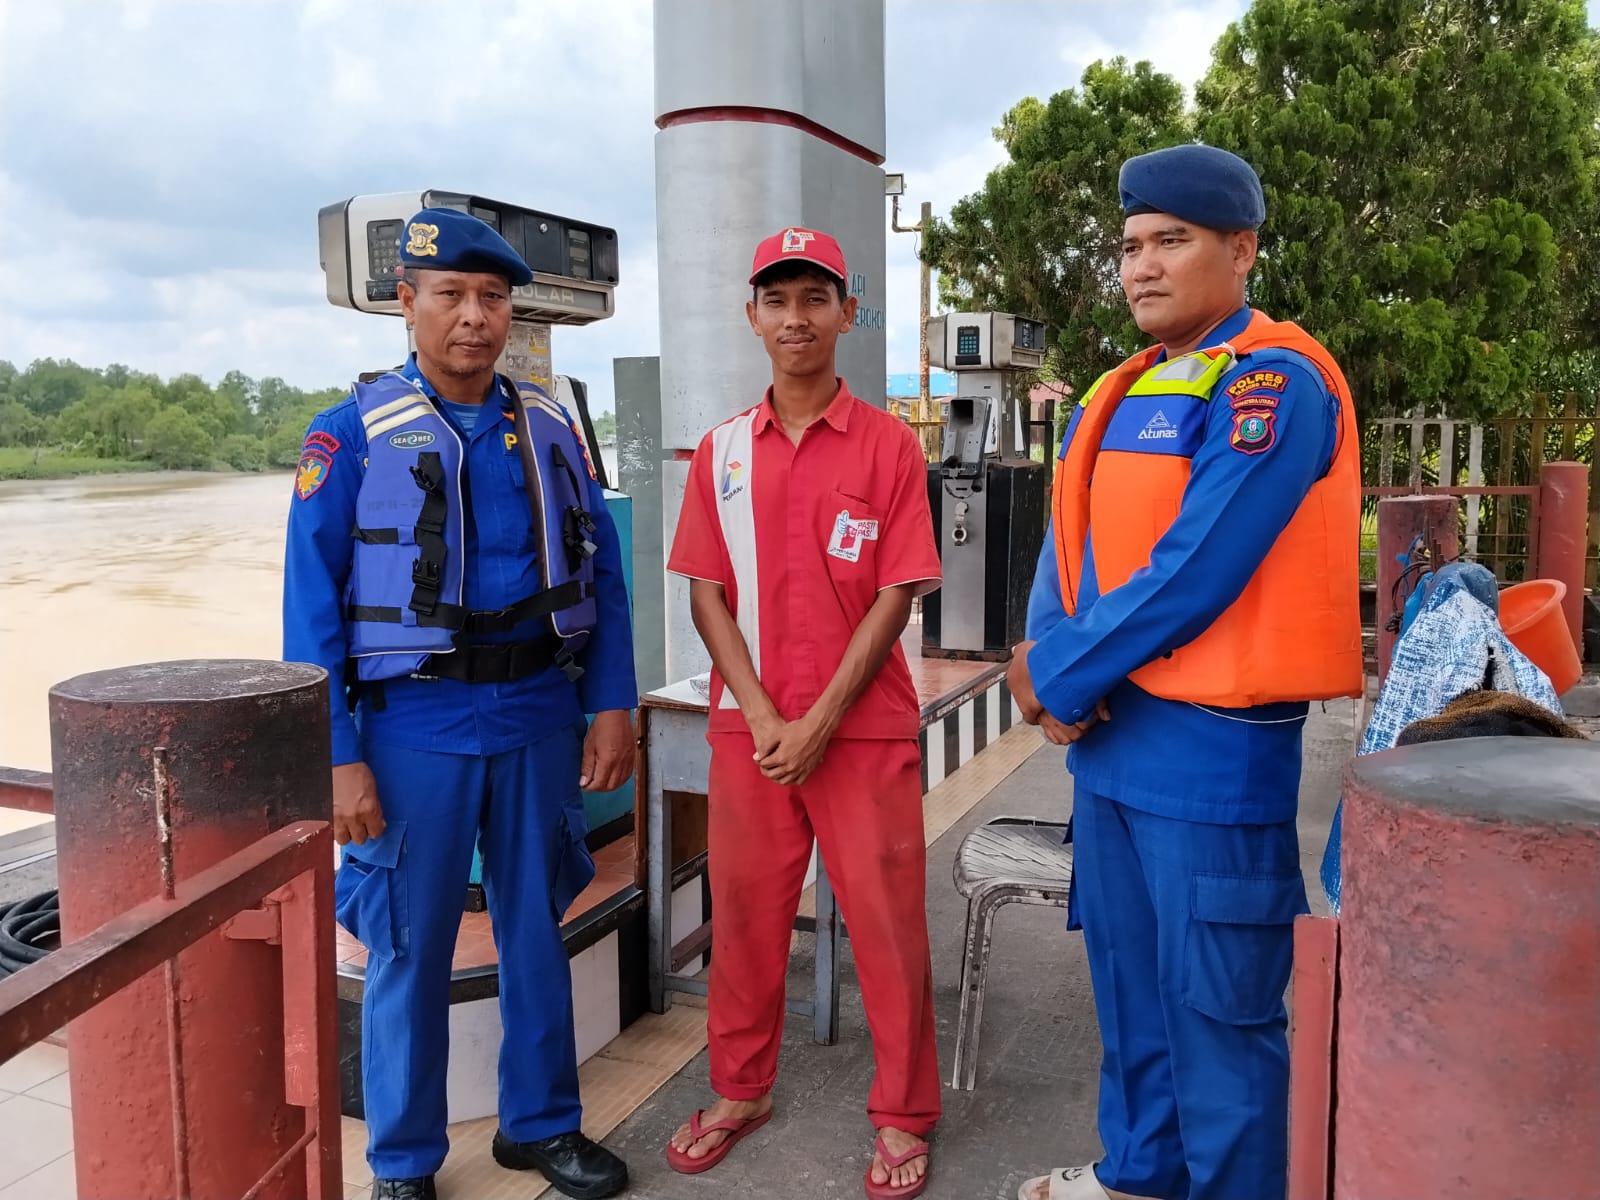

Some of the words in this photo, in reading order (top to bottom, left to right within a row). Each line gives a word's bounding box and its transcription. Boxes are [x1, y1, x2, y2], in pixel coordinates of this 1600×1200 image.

[852, 272, 865, 296] API
[853, 306, 886, 330] EROKOK
[1229, 373, 1283, 394] POLRES
[1138, 428, 1178, 439] Atunas
